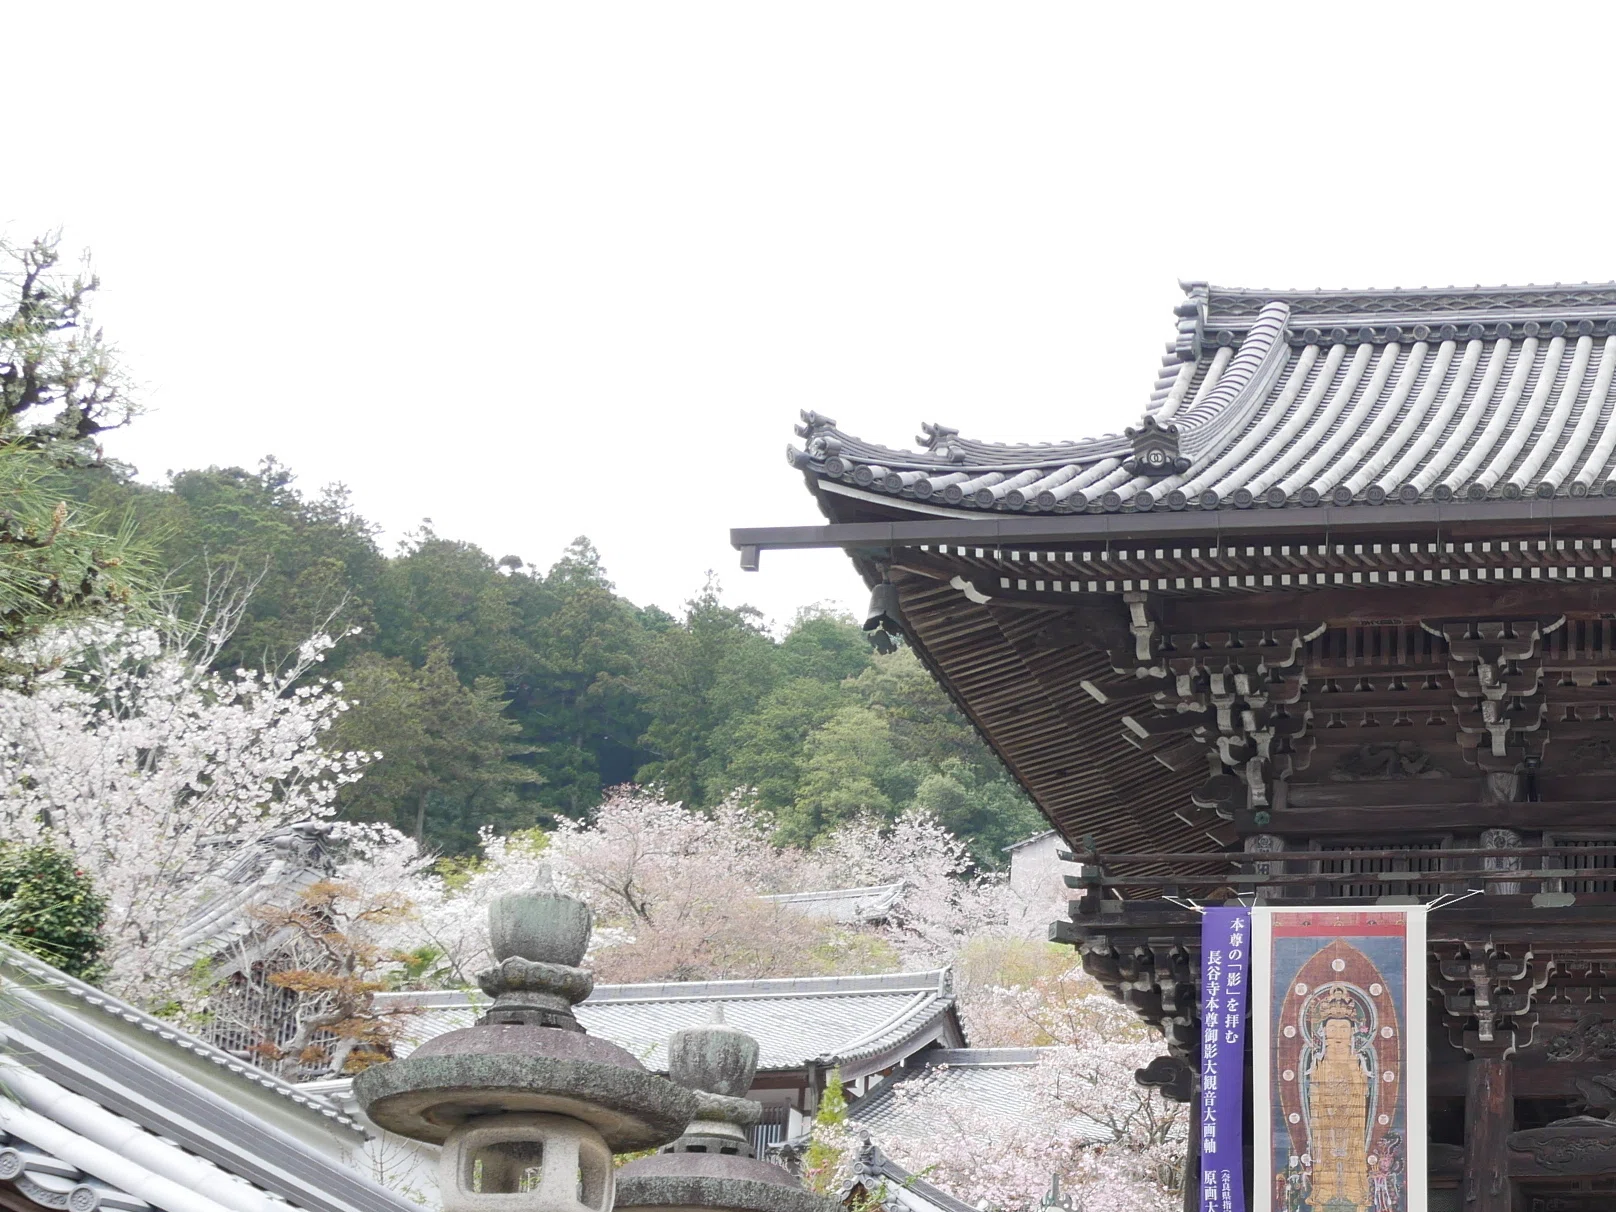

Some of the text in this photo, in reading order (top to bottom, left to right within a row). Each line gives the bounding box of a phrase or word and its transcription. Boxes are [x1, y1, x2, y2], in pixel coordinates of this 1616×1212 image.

[1203, 950, 1222, 1154] 長谷寺本尊御影大観音大画軸
[1225, 917, 1245, 1044] 本尊の「影」を拝む
